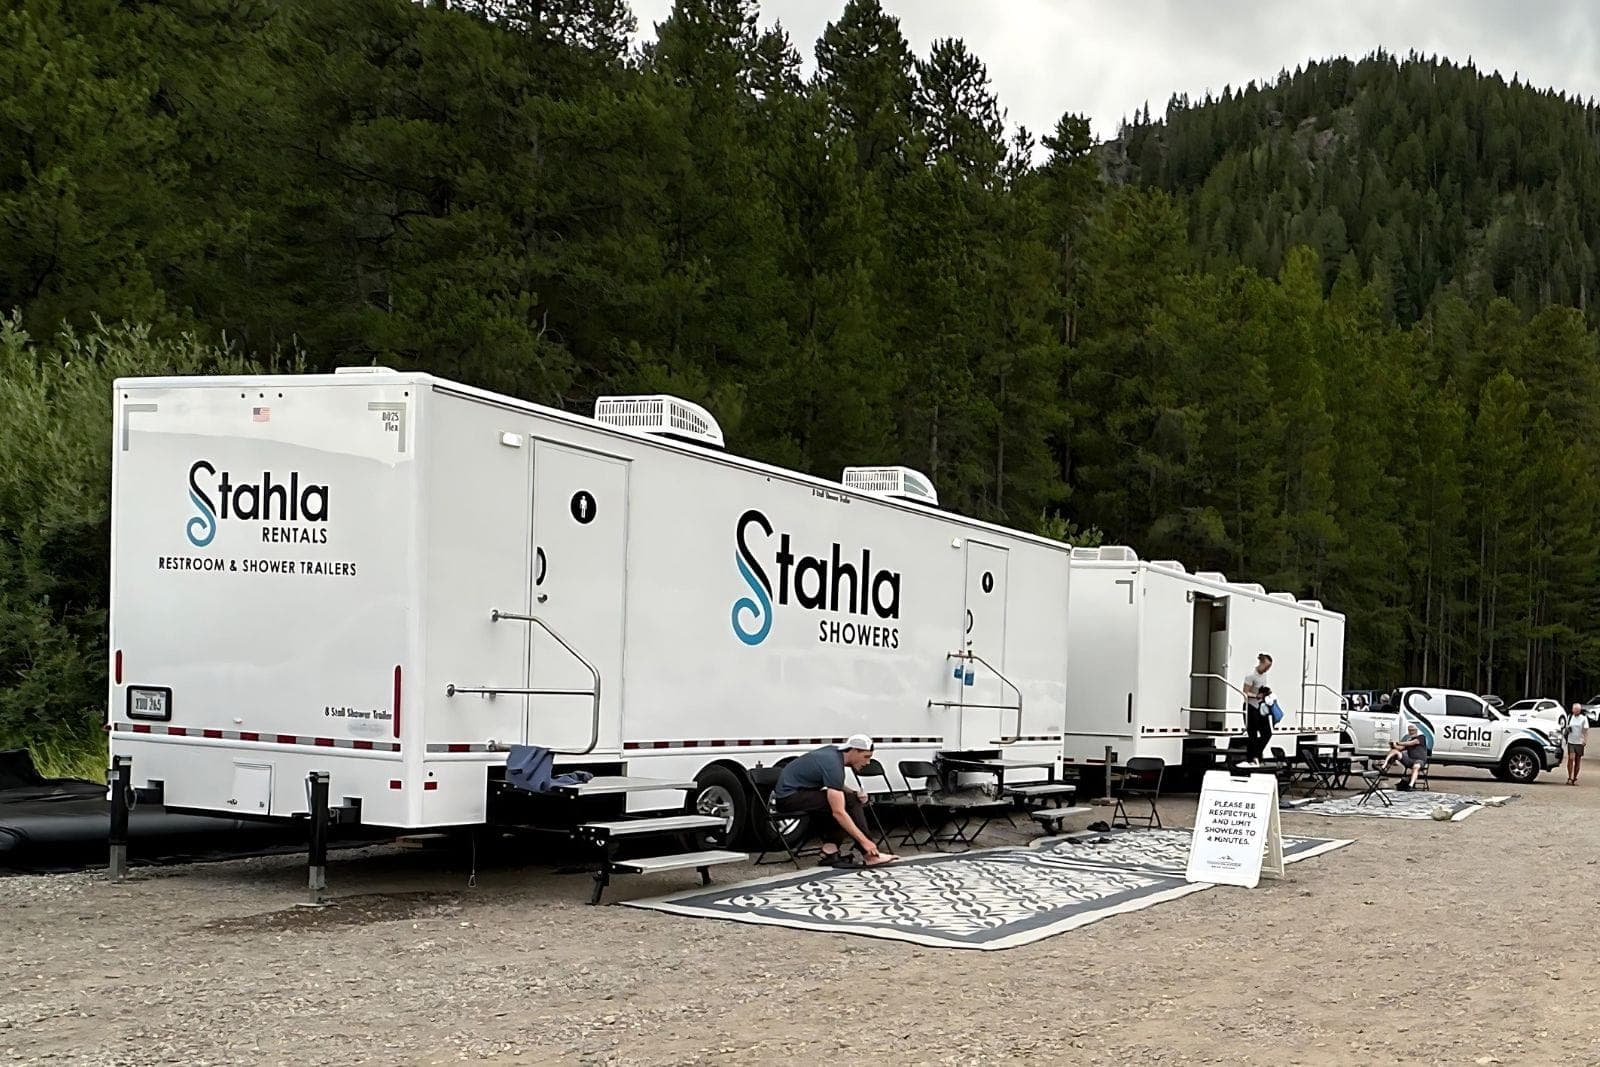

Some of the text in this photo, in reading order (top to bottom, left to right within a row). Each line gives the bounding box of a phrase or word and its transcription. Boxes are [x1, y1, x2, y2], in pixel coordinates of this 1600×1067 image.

[187, 460, 329, 548] Stahla
[262, 527, 328, 545] RENTALS
[158, 556, 357, 577] RESTROOM & SHOWER TRAILERS
[731, 509, 901, 646] Stahla
[819, 620, 899, 649] SHOWERS
[324, 706, 393, 720] 8 Stall Shower Trailer
[1443, 725, 1492, 742] Stahla
[1214, 800, 1256, 810] PLEASE BE
[1208, 809, 1258, 819] RESPECTFUL
[1212, 818, 1229, 826] AND
[1204, 826, 1256, 837] SHOWERS TO
